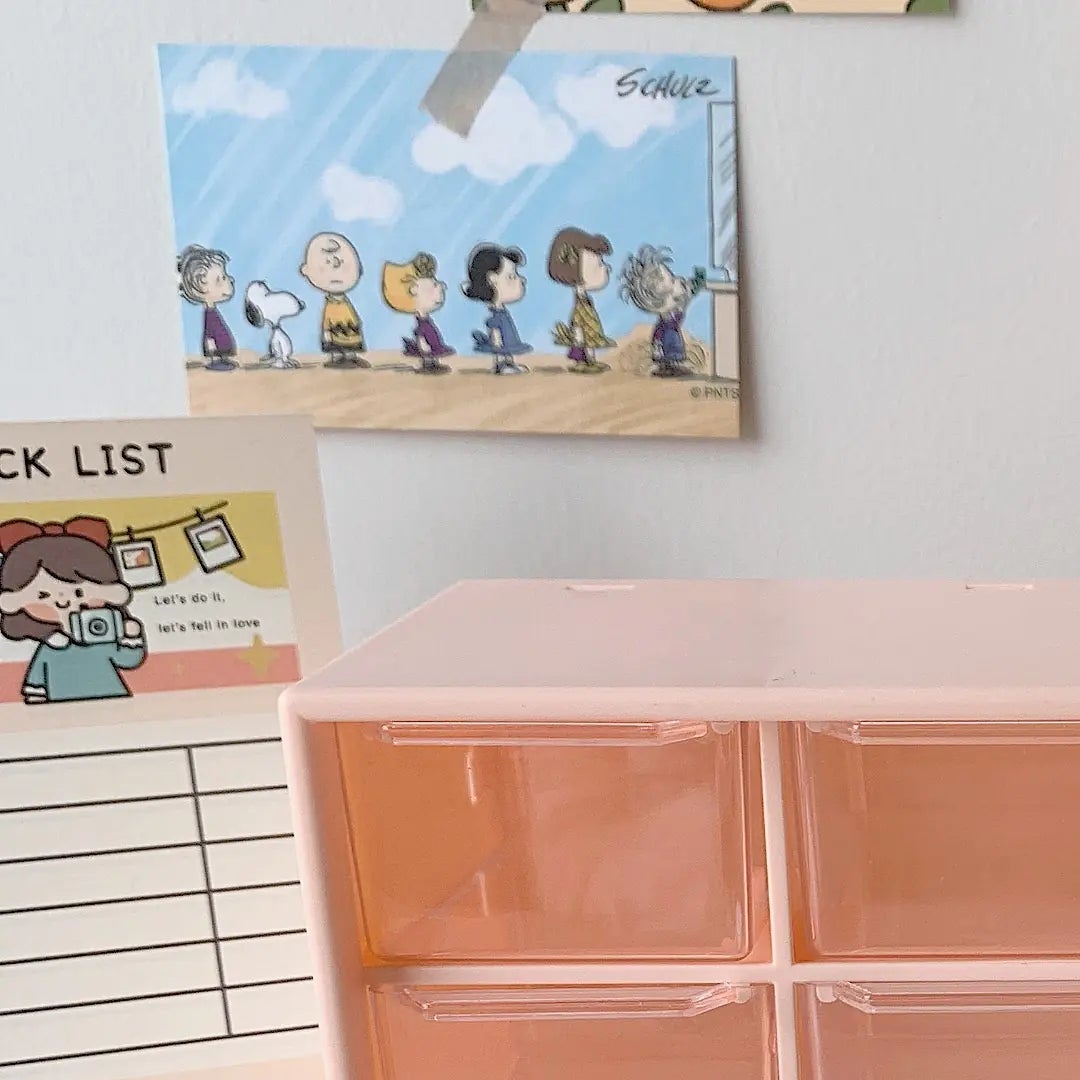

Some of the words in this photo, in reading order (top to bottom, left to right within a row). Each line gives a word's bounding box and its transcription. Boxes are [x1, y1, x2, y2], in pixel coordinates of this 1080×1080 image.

[74, 442, 174, 476] LIST
[154, 592, 187, 606] Let's
[191, 592, 209, 605] do
[158, 619, 188, 634] let's
[216, 618, 230, 632] in
[233, 616, 262, 632] love
